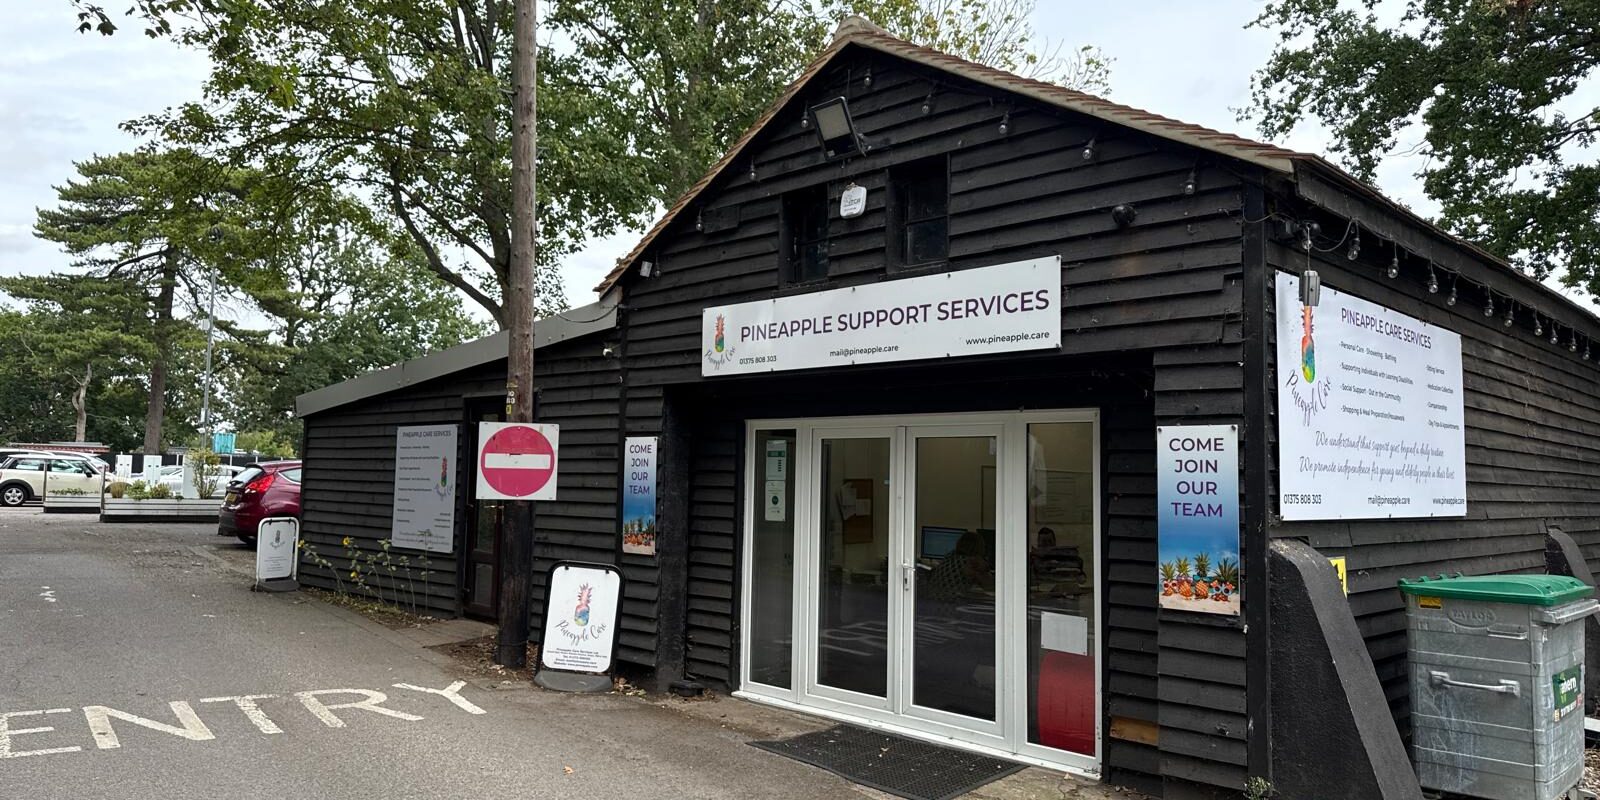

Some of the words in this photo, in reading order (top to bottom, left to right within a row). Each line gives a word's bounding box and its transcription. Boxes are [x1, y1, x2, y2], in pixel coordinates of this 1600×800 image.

[741, 316, 833, 342] PINEAPPLE
[837, 304, 932, 332] SUPPORT
[937, 289, 1050, 321] SERVICES
[1341, 307, 1384, 334] PINEAPPLE
[1384, 322, 1402, 340] CARE
[1402, 328, 1432, 349] SERVICES
[965, 330, 1050, 345] www.pineapple.care
[725, 346, 736, 361] Care
[829, 344, 899, 357] mail@pineapple.care
[740, 357, 754, 365] 01375
[755, 356, 766, 364] 808
[1285, 369, 1318, 427] Pineapple
[1317, 376, 1331, 410] Care
[1169, 437, 1224, 452] COME
[1315, 430, 1328, 446] We
[1329, 433, 1360, 450] understand
[1360, 435, 1371, 450] that
[629, 444, 652, 454] COME
[631, 458, 649, 467] JOIN
[1174, 459, 1218, 473] JOIN
[1299, 455, 1313, 472] We
[1313, 461, 1336, 479] promote
[1337, 459, 1370, 480] independence
[1370, 461, 1379, 480] for
[631, 471, 648, 481] OUR
[629, 485, 650, 495] TEAM
[1176, 480, 1217, 495] OUR
[1283, 494, 1299, 505] 01375
[1300, 494, 1311, 505] 808
[1311, 494, 1322, 504] 303
[1367, 495, 1411, 507] mail@pineapple.care
[1432, 497, 1465, 506] www.pineapple.care
[1170, 502, 1223, 517] TEAM
[555, 619, 589, 646] Pineapple
[590, 623, 607, 639] Care
[0, 680, 487, 758] ENTRY
